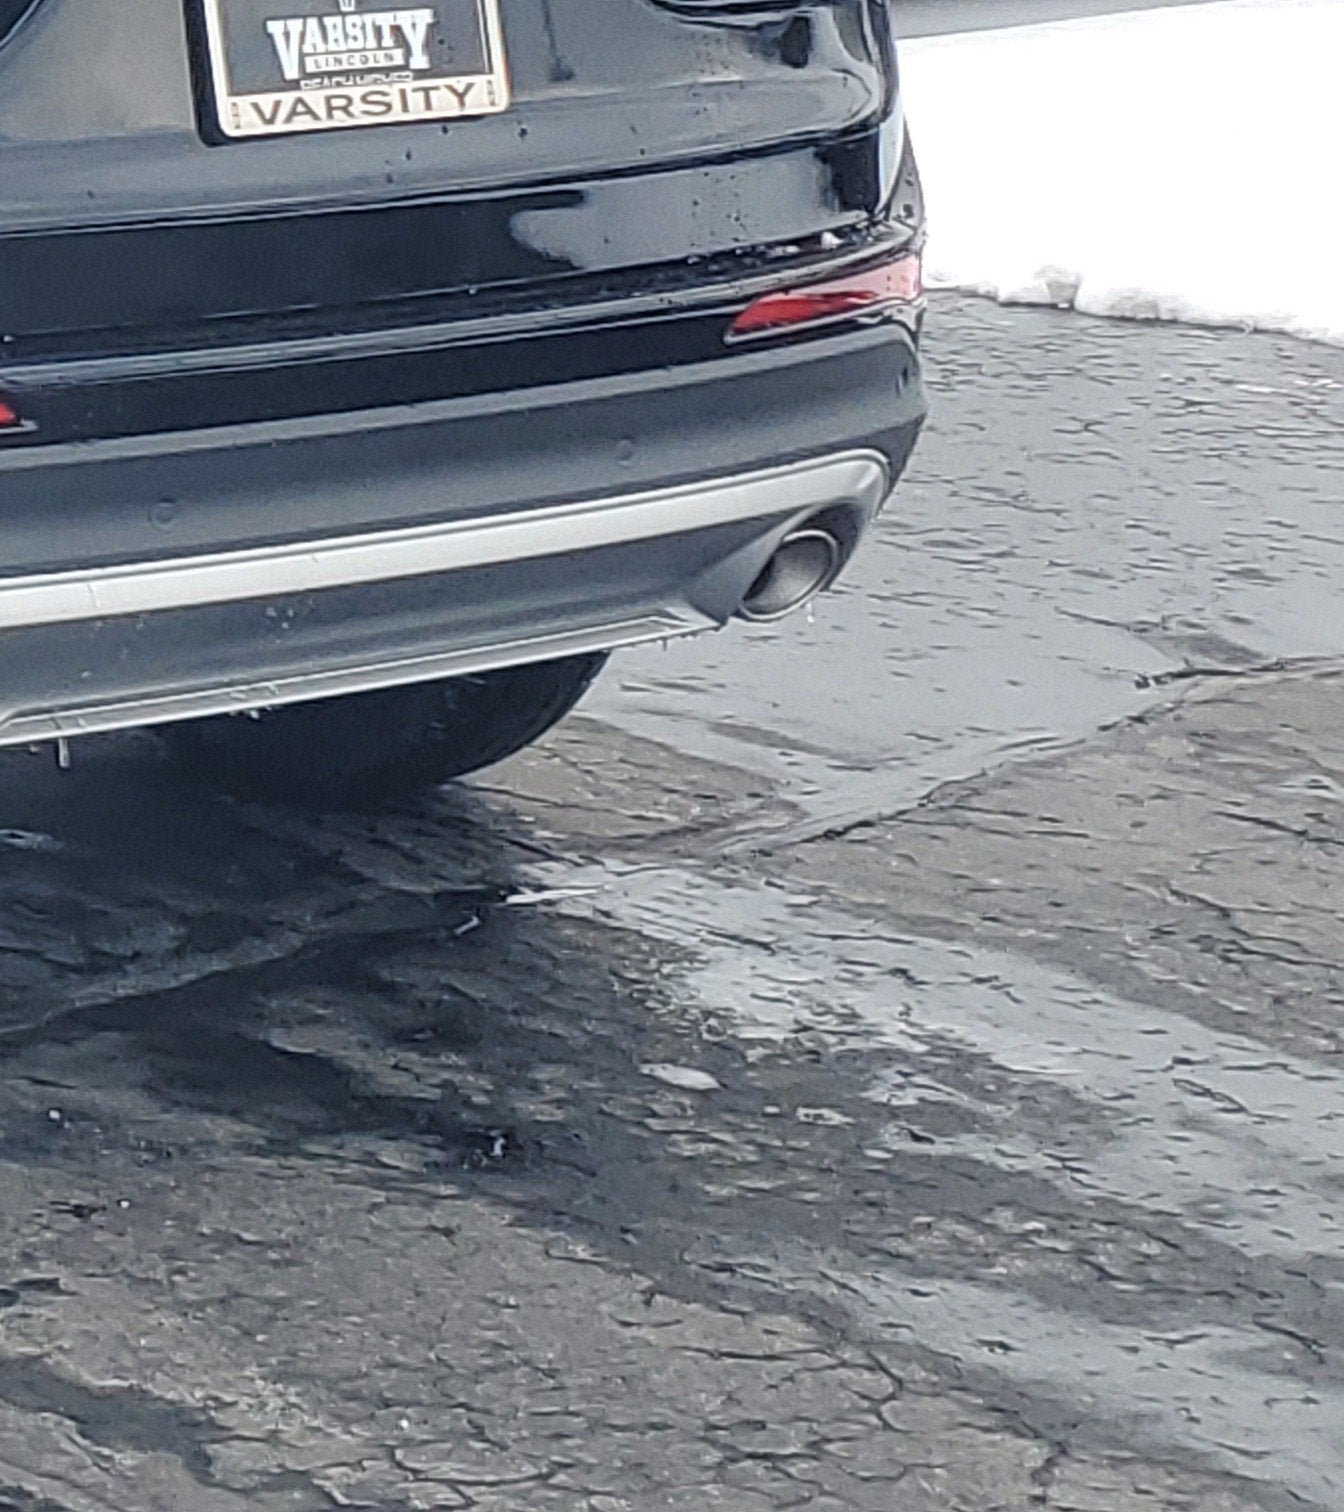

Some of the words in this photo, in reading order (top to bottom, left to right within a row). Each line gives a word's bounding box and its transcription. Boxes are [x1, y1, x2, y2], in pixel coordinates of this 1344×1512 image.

[266, 8, 435, 81] VARSITY
[313, 52, 395, 70] LINCOLN
[250, 81, 476, 126] VARSITY
